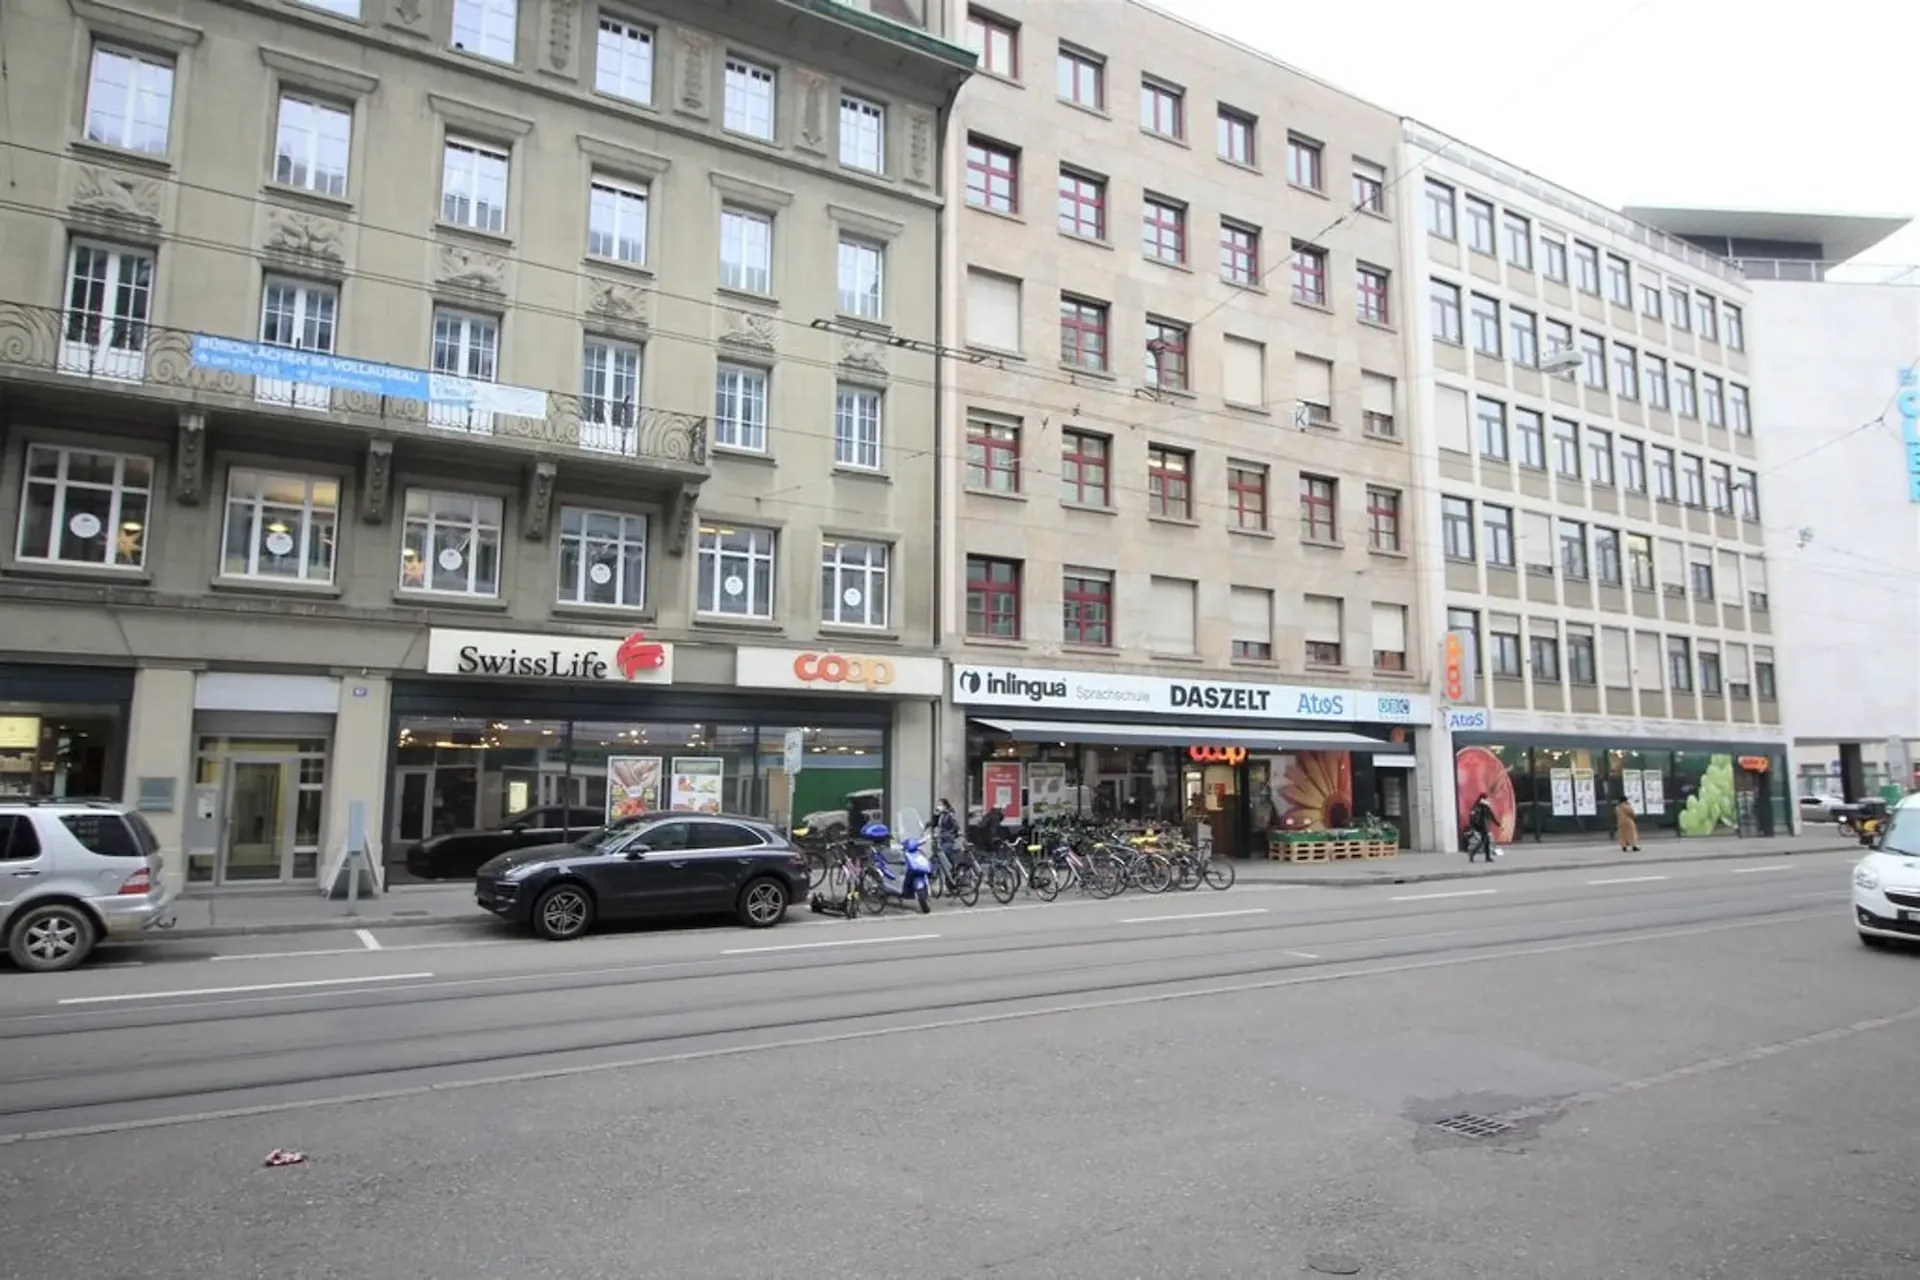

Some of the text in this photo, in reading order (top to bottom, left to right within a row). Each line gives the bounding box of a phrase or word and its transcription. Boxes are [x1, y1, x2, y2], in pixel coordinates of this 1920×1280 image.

[794, 653, 895, 691] coop
[987, 672, 1150, 702] inlingua Sprachschule
